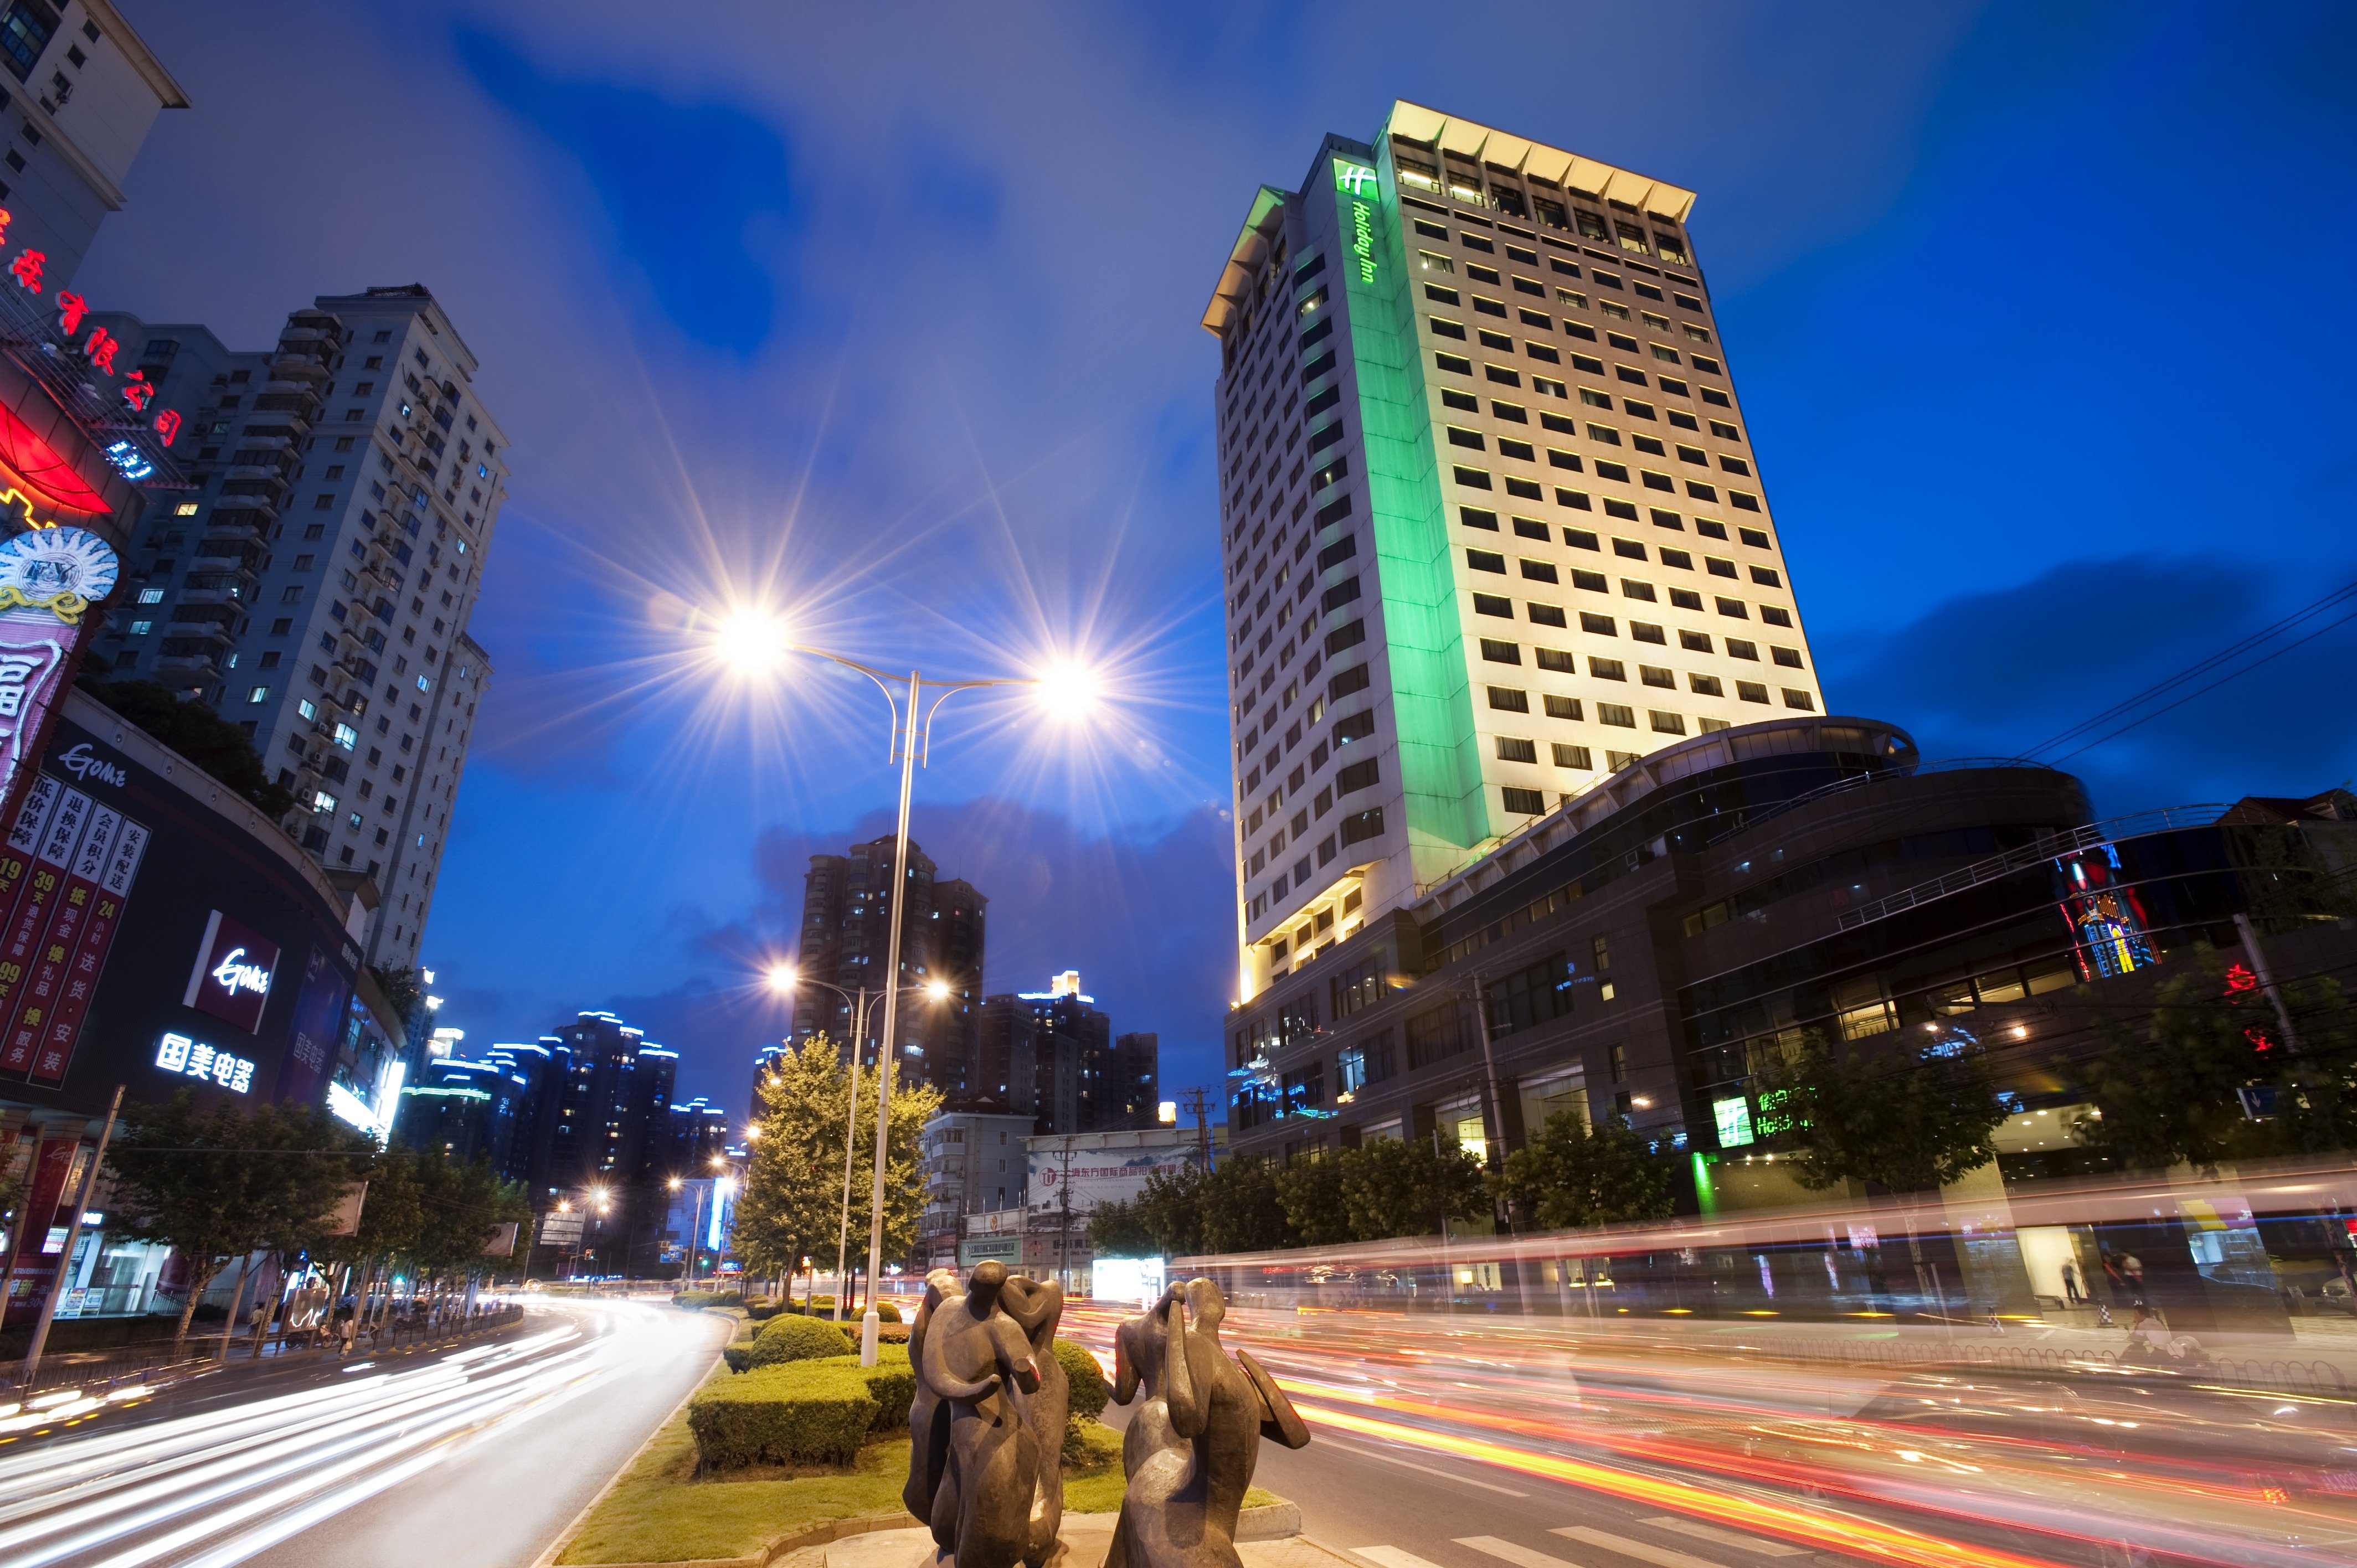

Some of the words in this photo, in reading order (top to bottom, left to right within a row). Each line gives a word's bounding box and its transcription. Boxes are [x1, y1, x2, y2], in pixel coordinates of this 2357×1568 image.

[1352, 202, 1373, 258] Holiday
[1360, 257, 1377, 284] Inn
[0, 208, 182, 446] 乐有限公司
[47, 795, 84, 859] 退换保障
[80, 813, 114, 875] 会员积分
[109, 829, 141, 890] 安装配送
[156, 1033, 255, 1094] 国美电器
[293, 1031, 326, 1075] 国美电器
